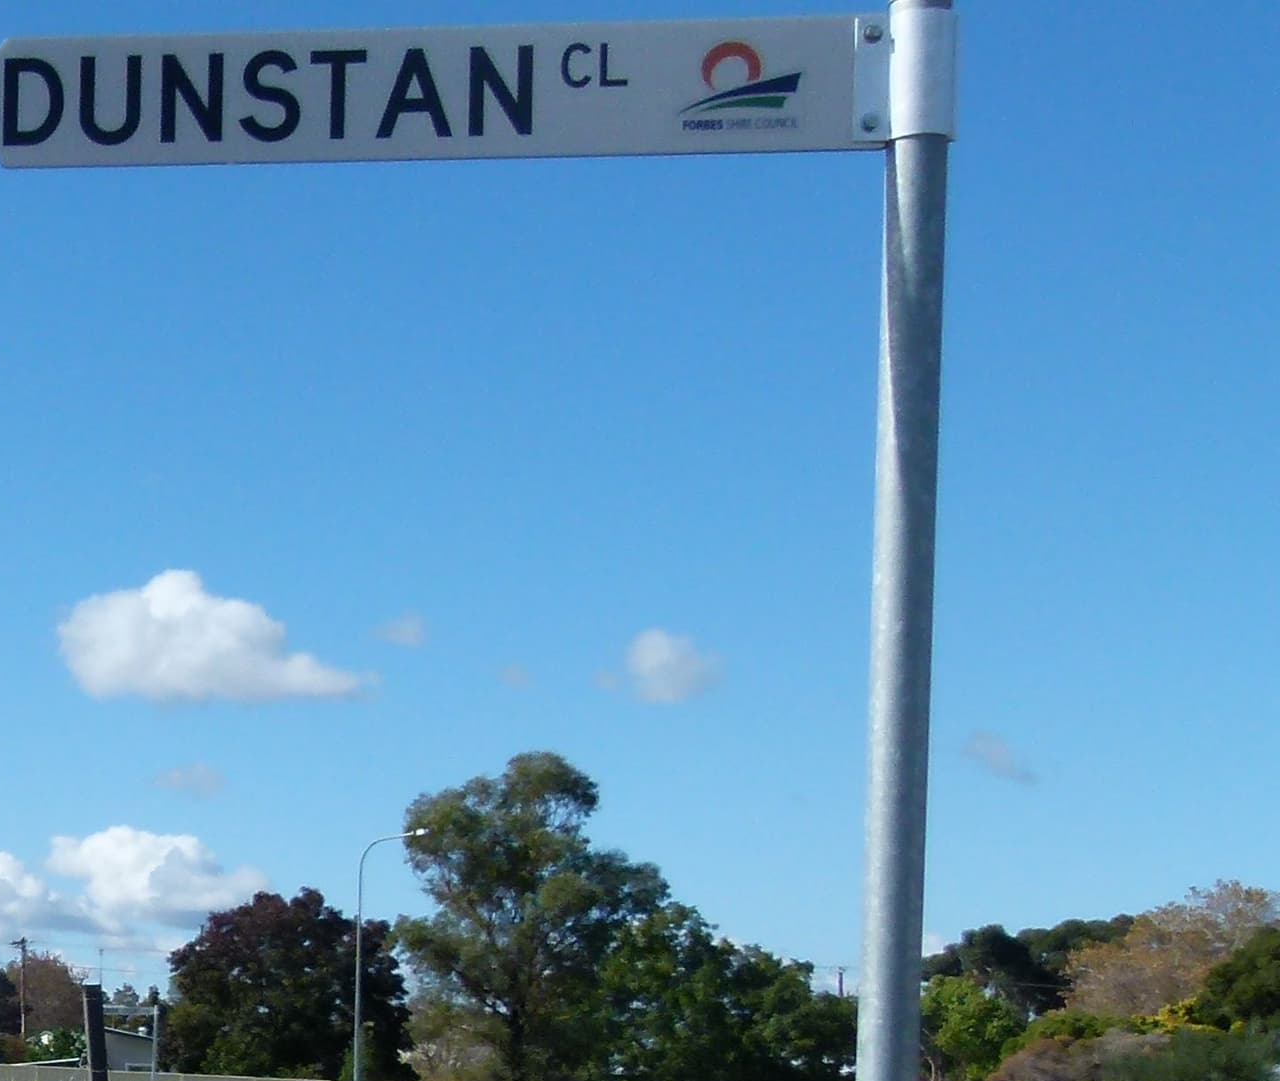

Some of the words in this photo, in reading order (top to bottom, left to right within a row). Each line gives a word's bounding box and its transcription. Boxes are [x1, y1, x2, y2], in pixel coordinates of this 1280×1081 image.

[2, 44, 534, 147] DUNSTAN
[561, 43, 629, 89] CL
[682, 118, 724, 131] FORBES
